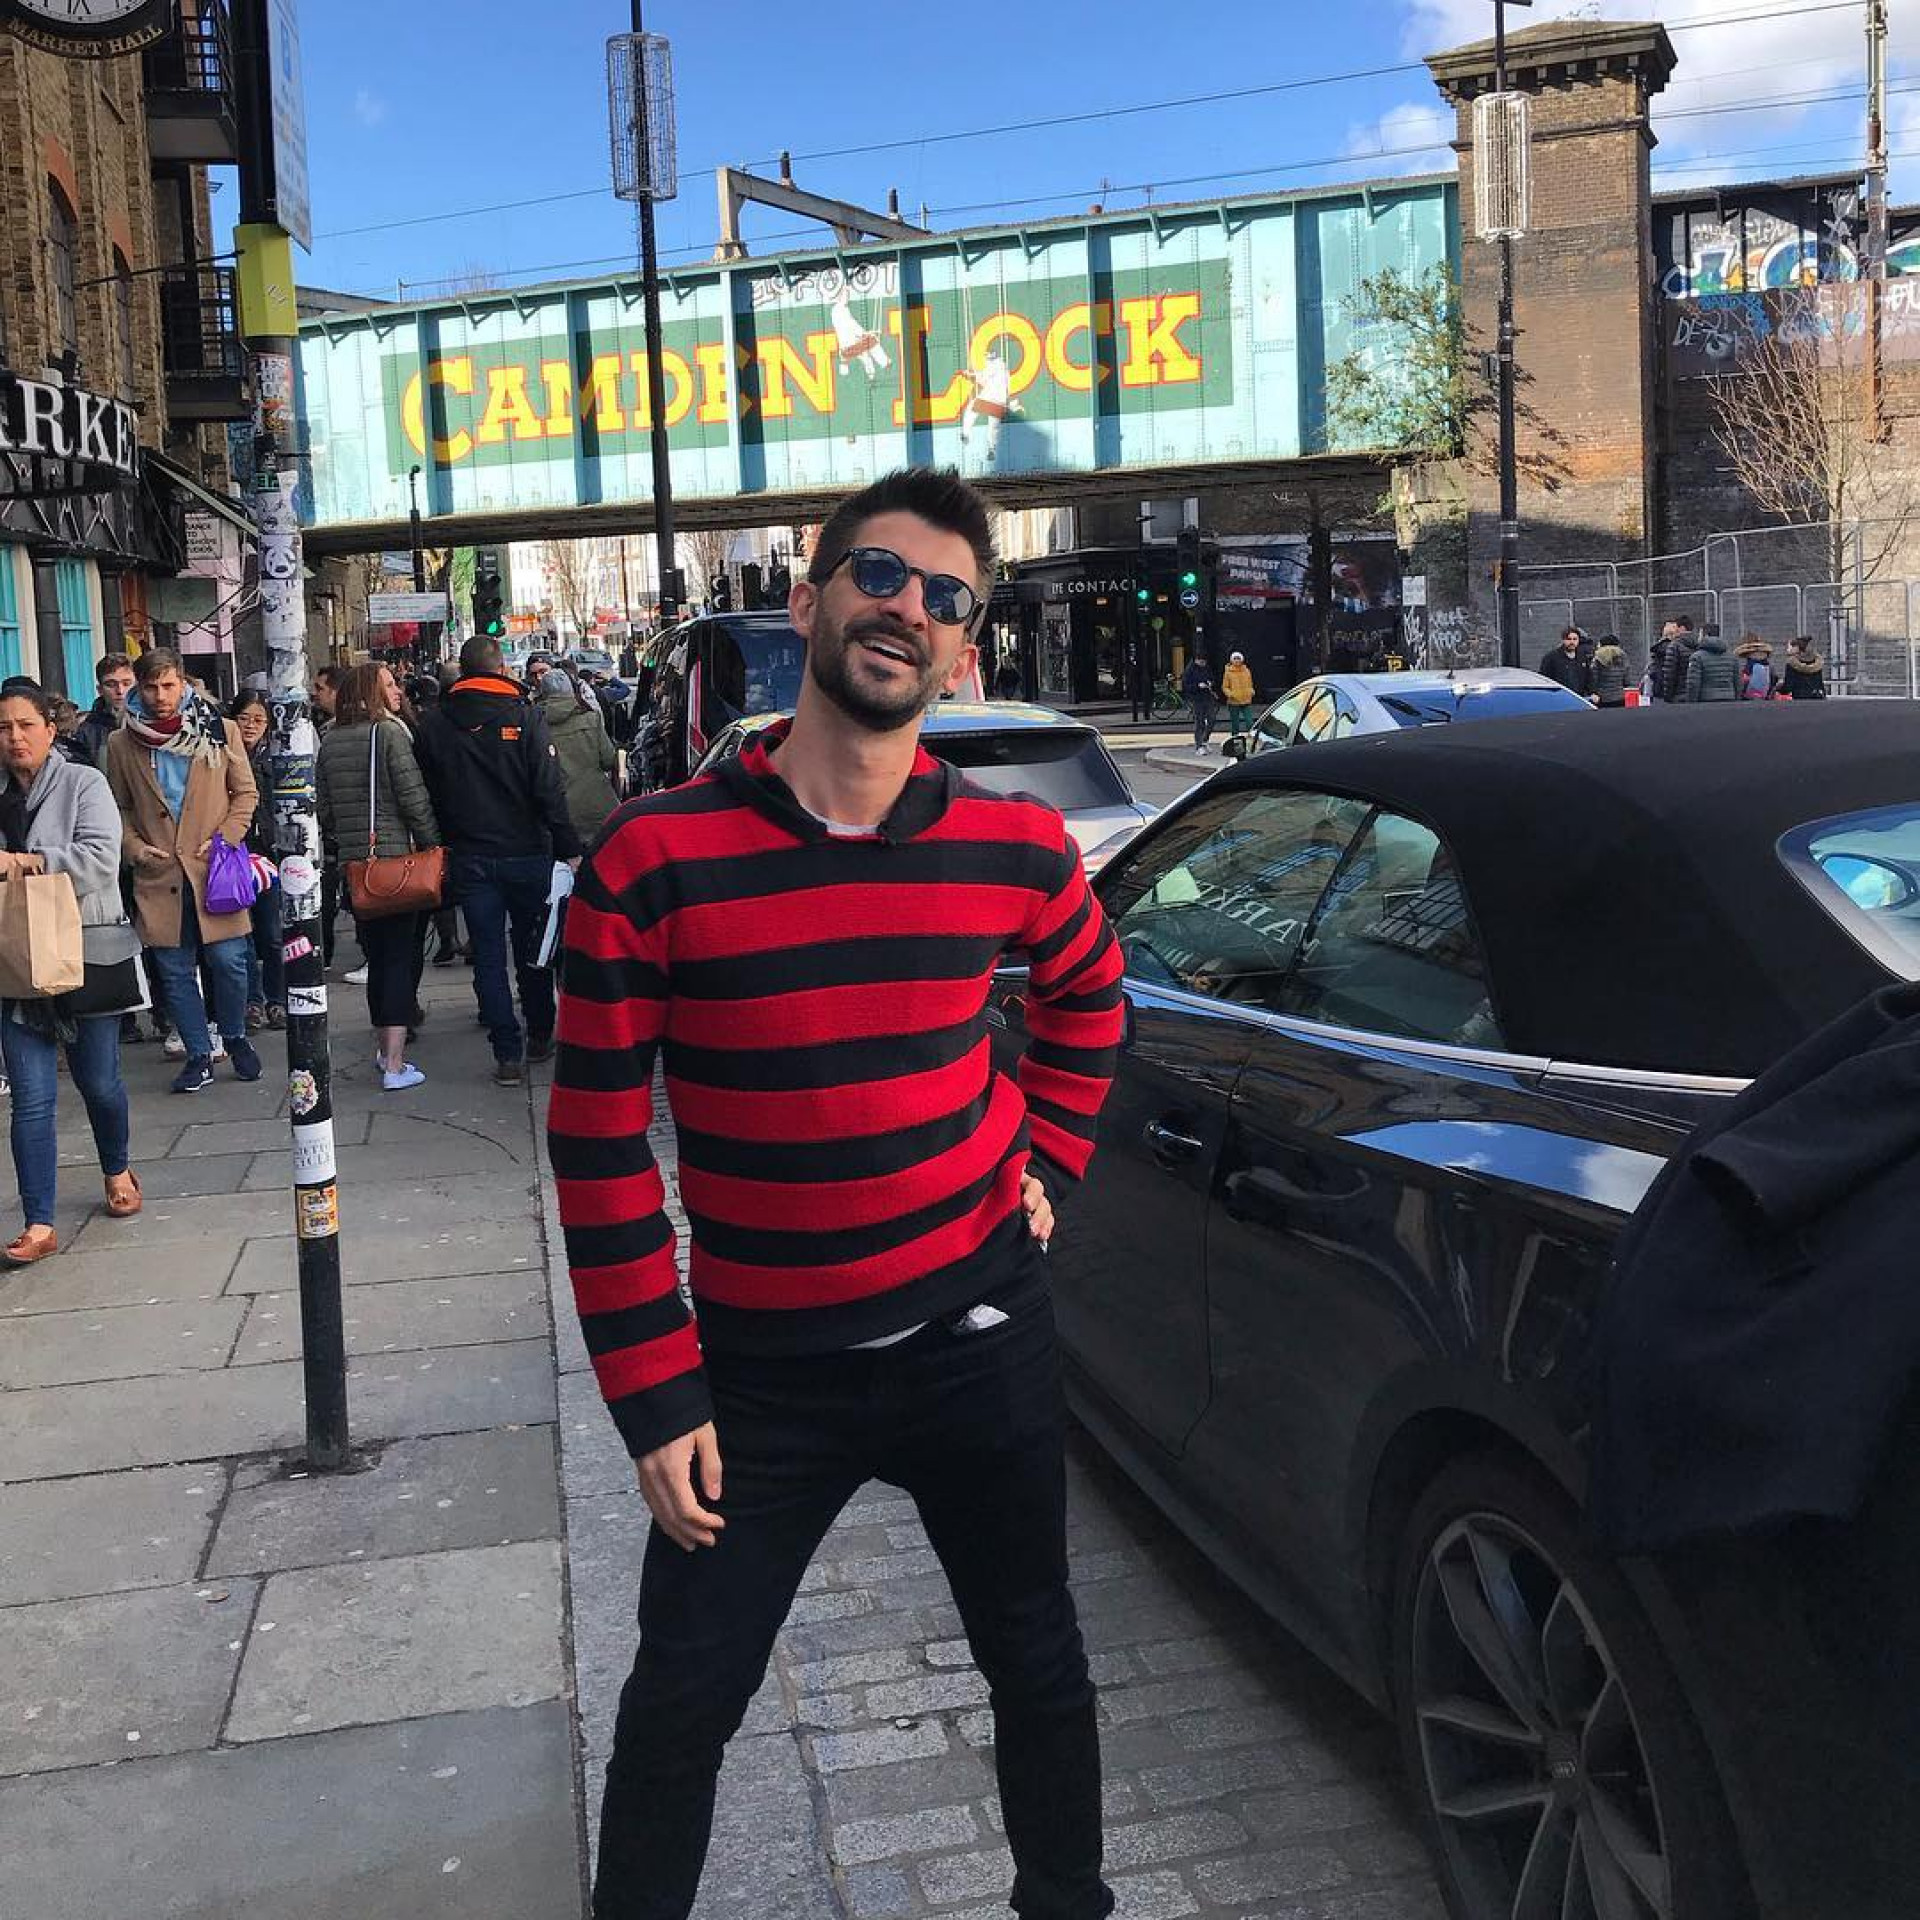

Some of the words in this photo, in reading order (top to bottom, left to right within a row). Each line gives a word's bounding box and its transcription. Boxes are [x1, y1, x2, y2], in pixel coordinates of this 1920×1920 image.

[8, 19, 102, 55] MARKET
[107, 23, 163, 51] HALL
[402, 331, 839, 464] CAMDEN
[887, 291, 1202, 426] LOCK
